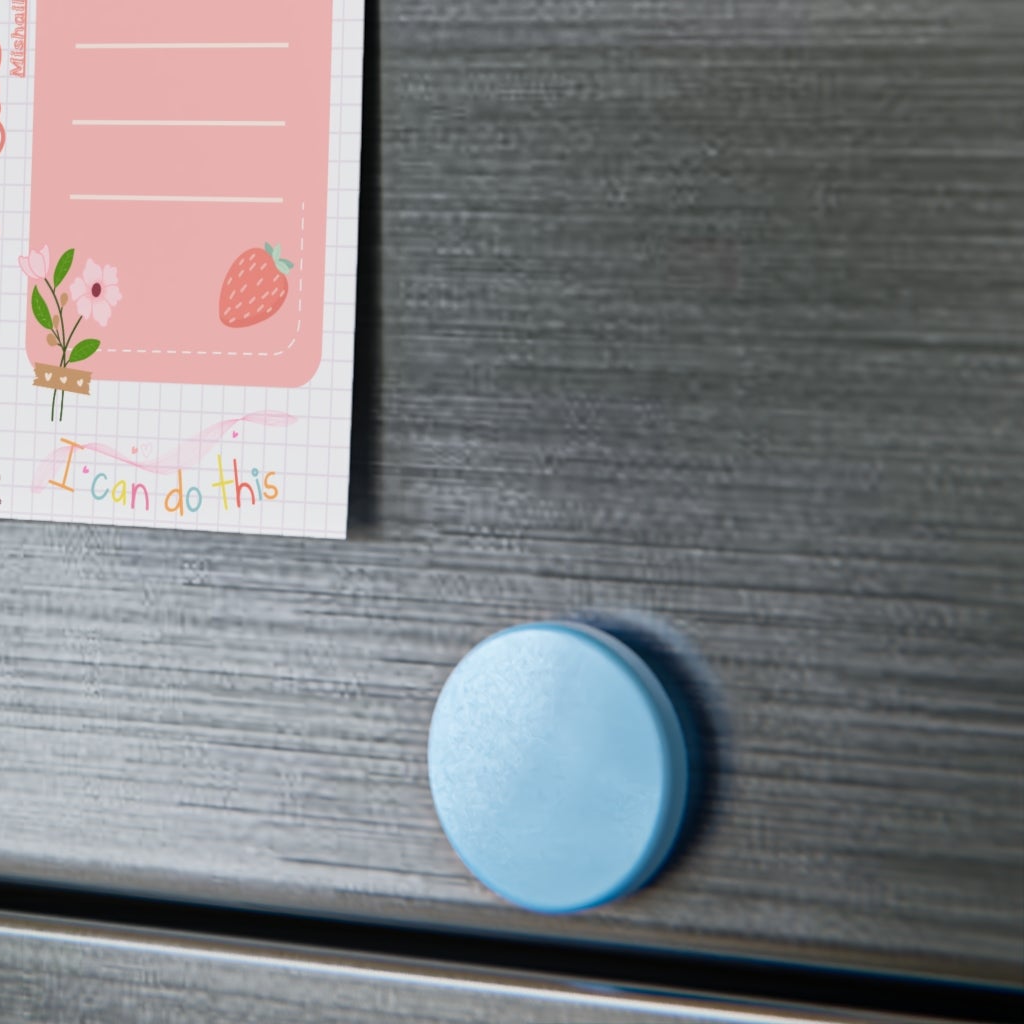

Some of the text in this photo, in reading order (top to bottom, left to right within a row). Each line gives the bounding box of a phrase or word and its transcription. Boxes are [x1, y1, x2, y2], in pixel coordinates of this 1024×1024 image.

[48, 437, 279, 517] I can do this
